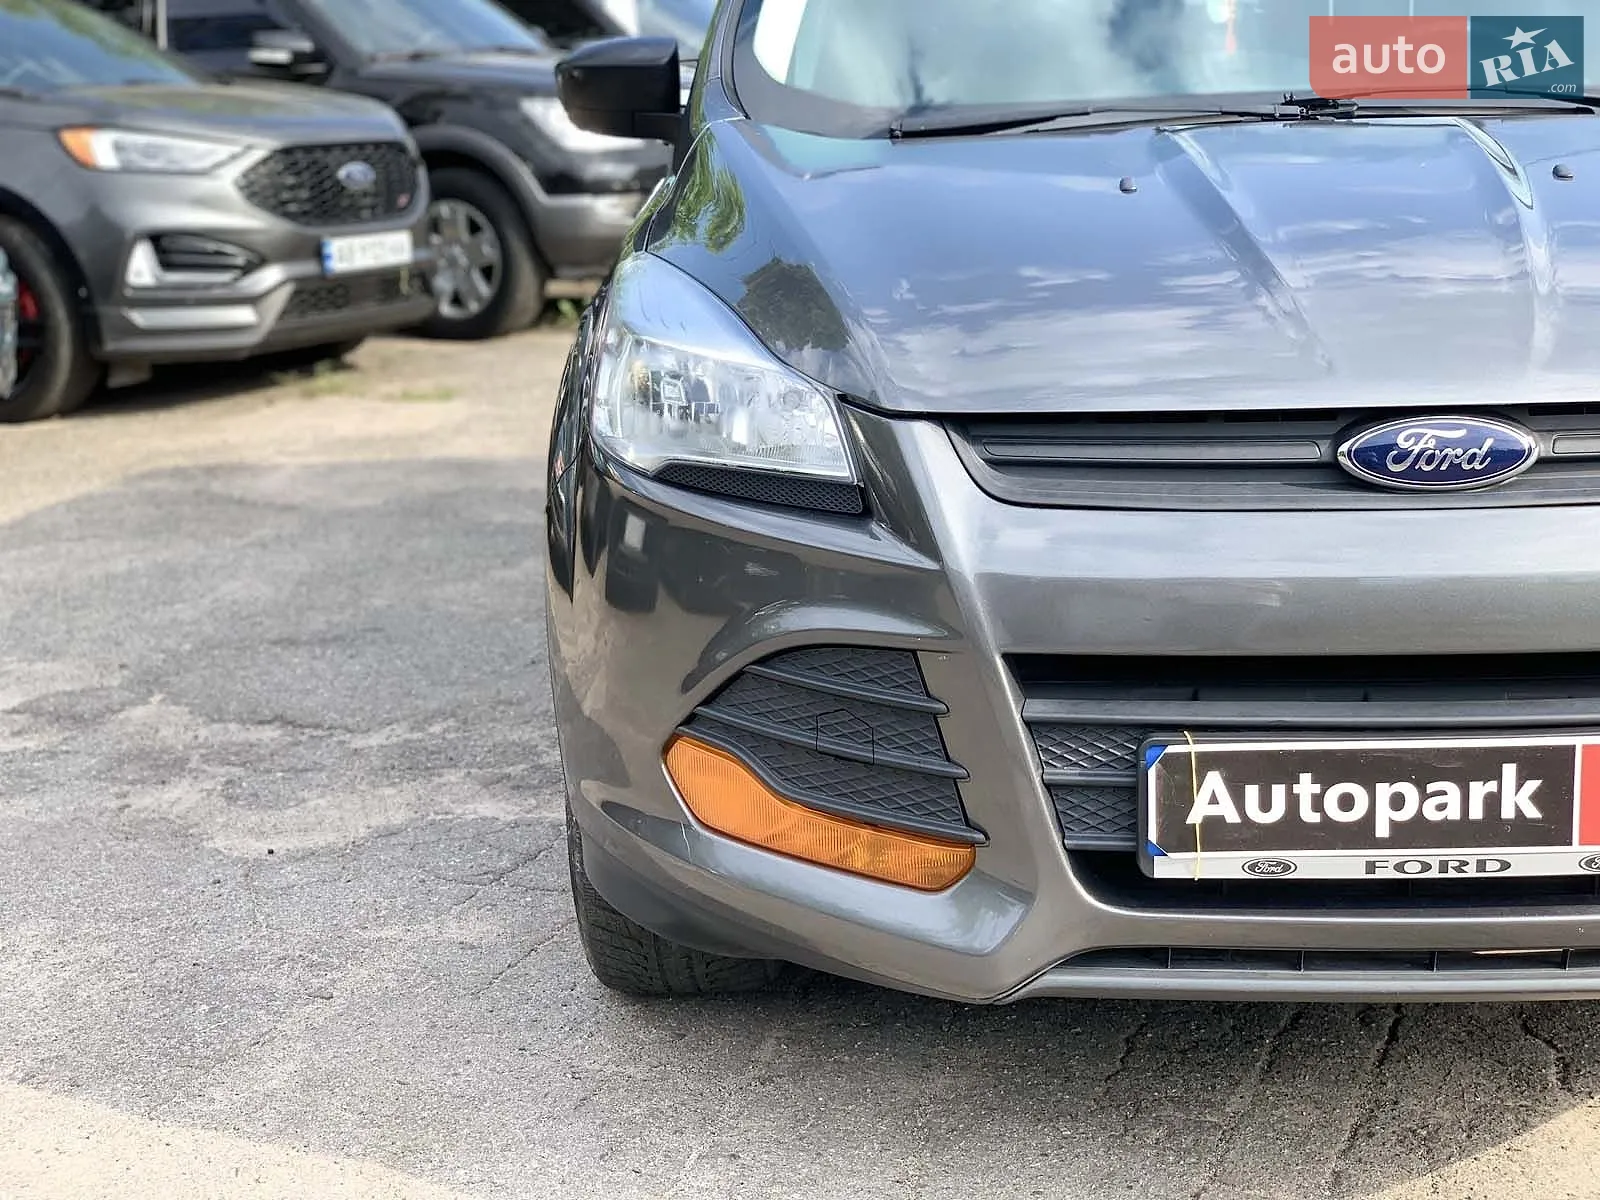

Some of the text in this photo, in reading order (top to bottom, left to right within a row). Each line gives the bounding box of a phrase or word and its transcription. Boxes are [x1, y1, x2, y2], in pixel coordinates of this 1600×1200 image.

[1385, 428, 1494, 472] Ford
[1185, 763, 1543, 838] Autopark
[1255, 858, 1511, 874] Ford FORD
